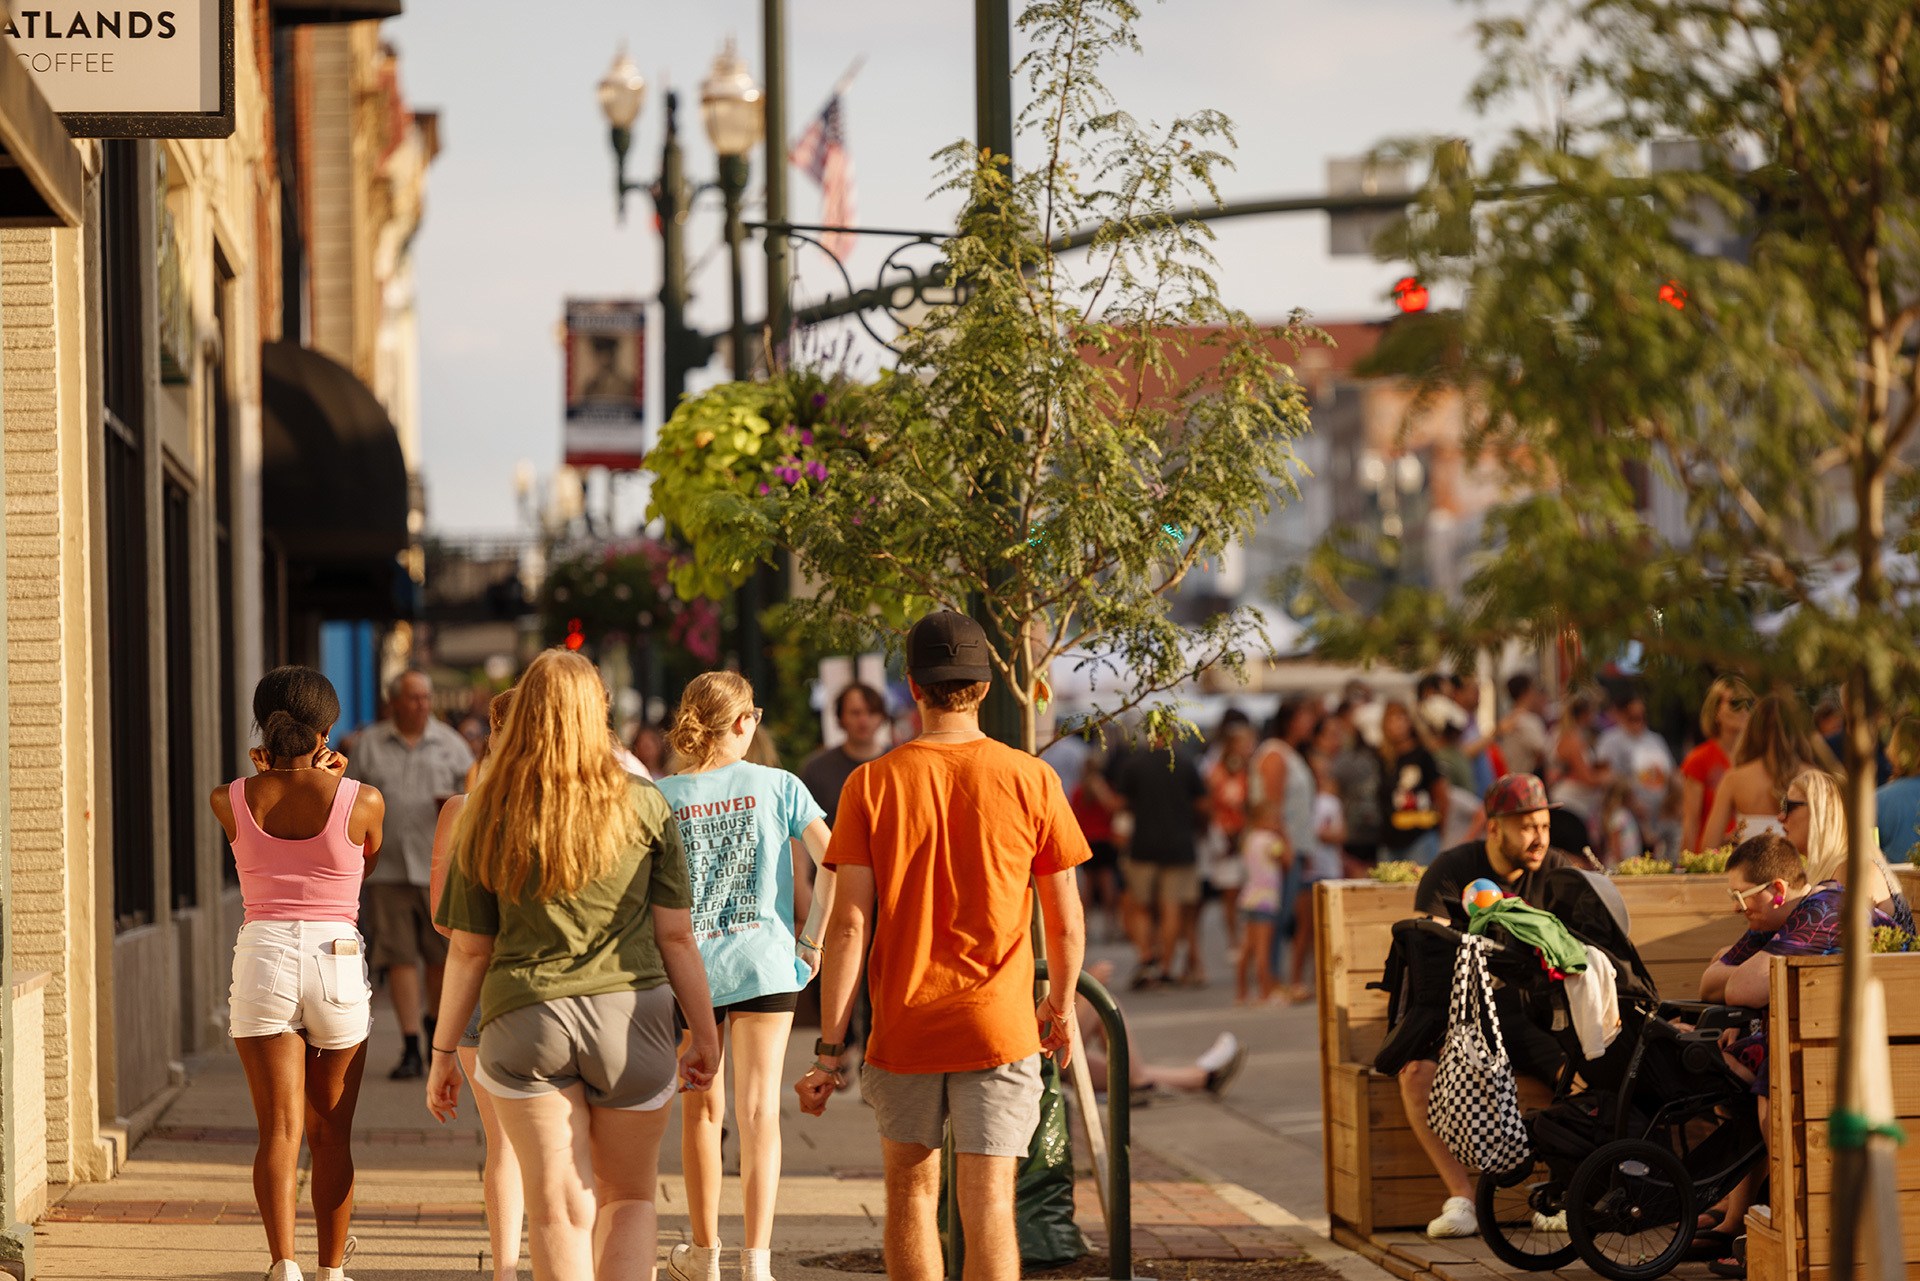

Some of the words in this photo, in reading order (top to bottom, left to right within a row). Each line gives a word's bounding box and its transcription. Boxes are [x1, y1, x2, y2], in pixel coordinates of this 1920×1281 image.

[674, 795, 757, 823] SURVIVED
[708, 832, 756, 850] LATE
[714, 863, 757, 879] GUDE
[704, 879, 757, 897] REACONARY
[718, 911, 756, 928] RVER
